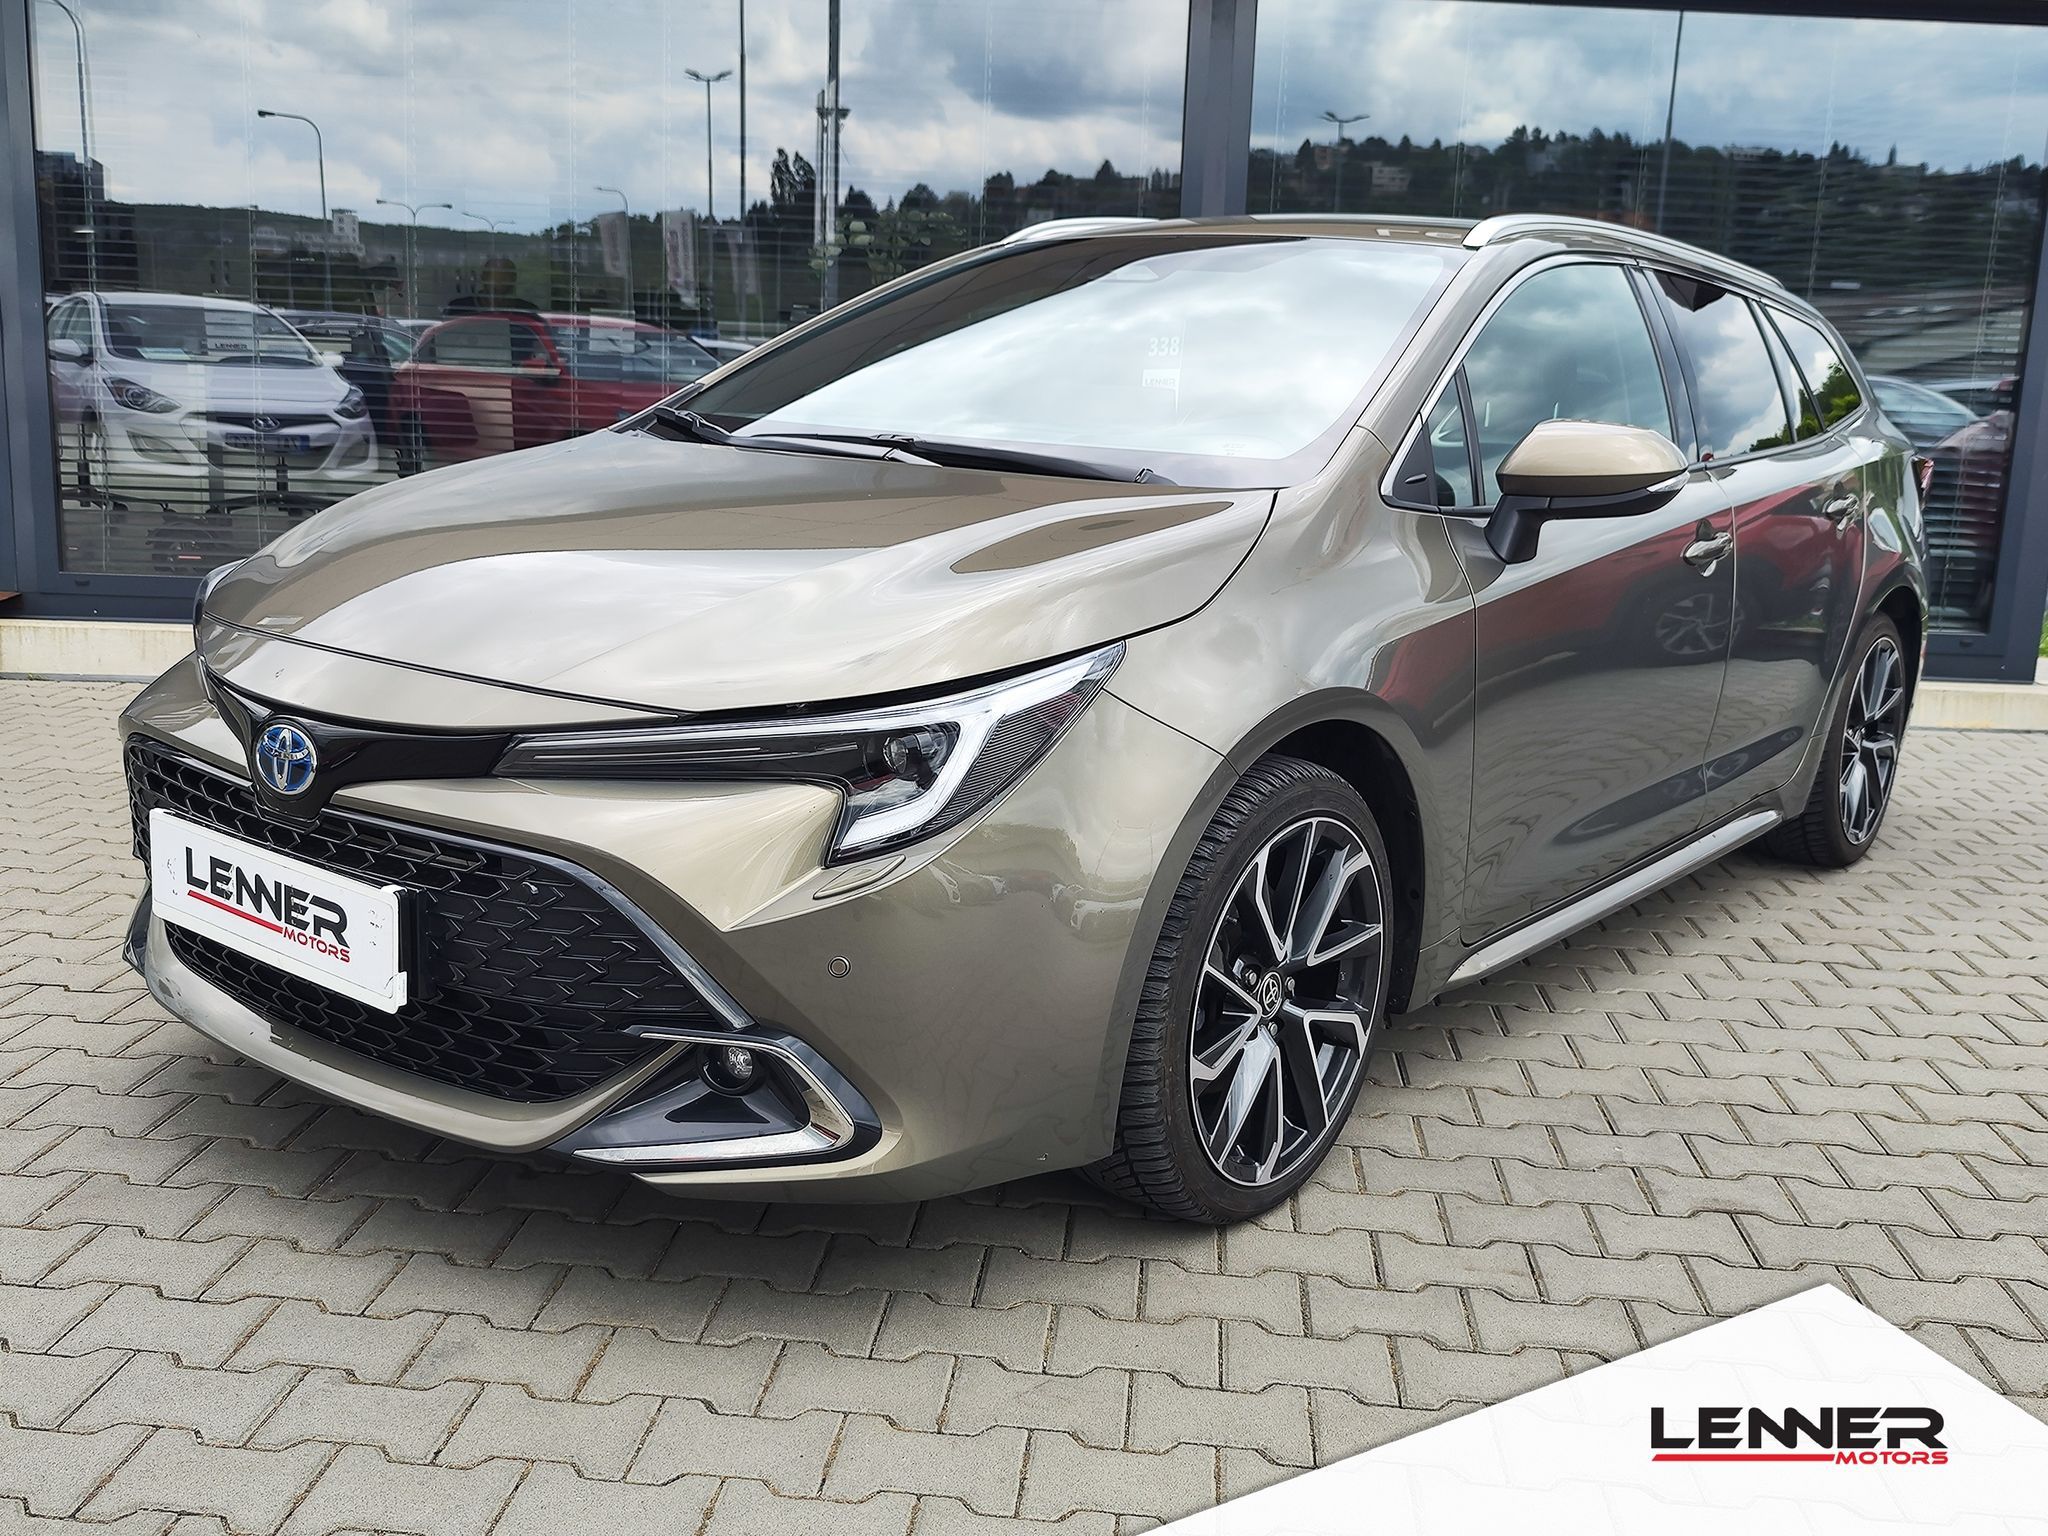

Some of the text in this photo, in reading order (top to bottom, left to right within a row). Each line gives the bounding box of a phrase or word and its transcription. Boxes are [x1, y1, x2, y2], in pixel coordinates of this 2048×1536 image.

[1148, 336, 1180, 357] 338
[185, 846, 350, 948] LENNER
[282, 926, 351, 964] MOTORS
